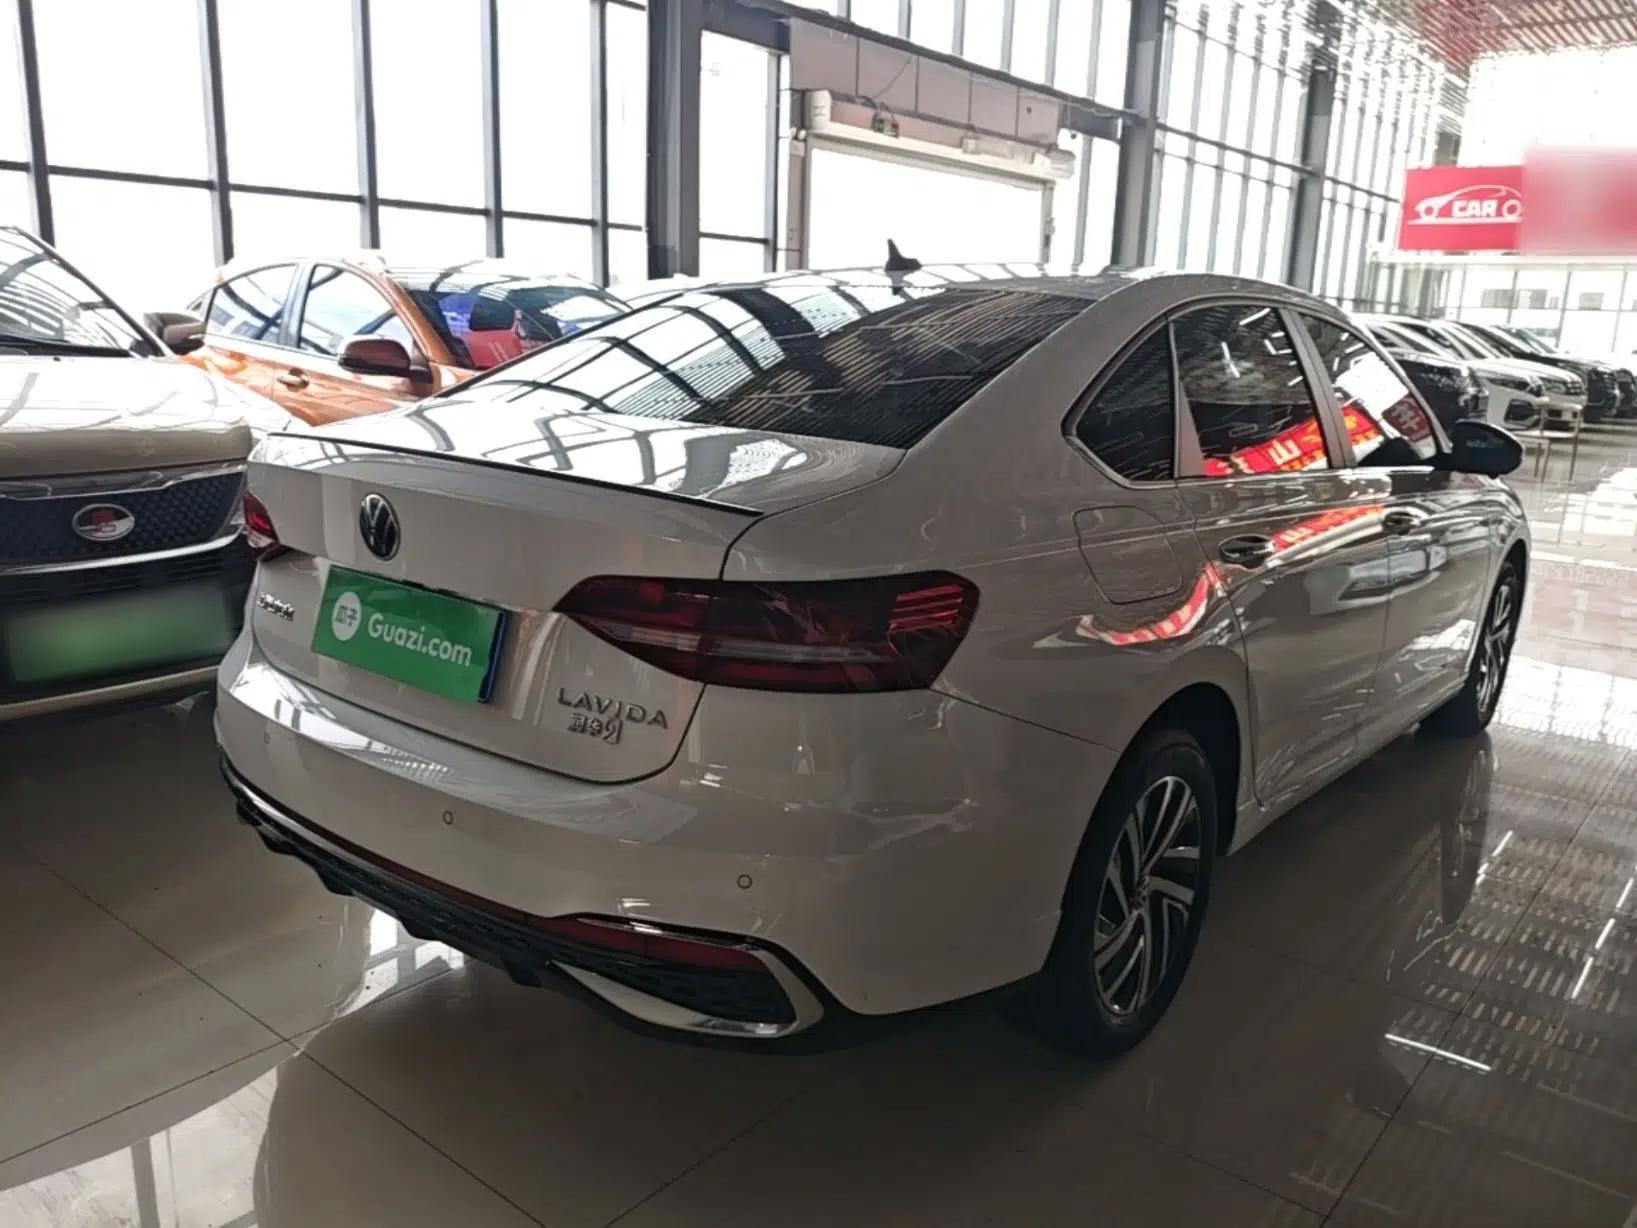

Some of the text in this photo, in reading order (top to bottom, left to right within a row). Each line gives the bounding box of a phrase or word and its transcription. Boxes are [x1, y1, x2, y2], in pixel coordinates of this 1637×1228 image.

[1451, 199, 1497, 218] CAR
[367, 612, 472, 667] Guazi.com
[557, 687, 668, 729] LAVIDA
